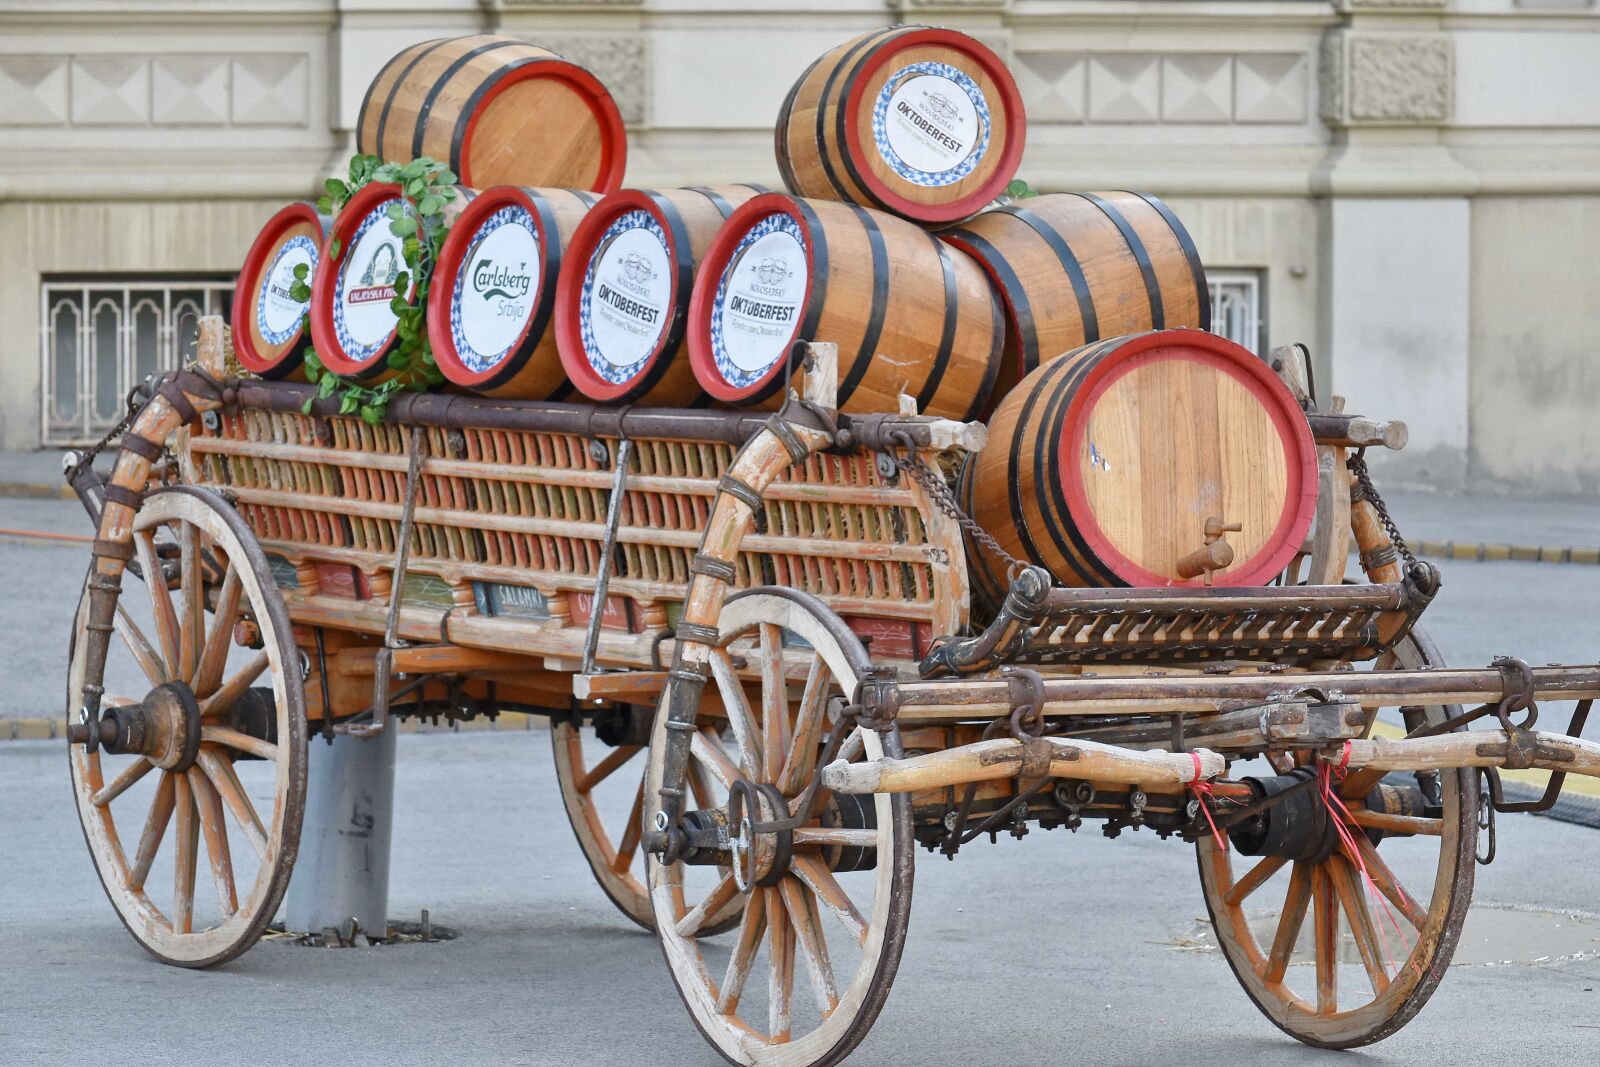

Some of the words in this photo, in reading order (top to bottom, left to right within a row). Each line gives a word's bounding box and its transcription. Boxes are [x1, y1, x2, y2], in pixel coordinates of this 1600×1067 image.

[897, 101, 963, 153] OKTOBERFEST
[271, 284, 293, 300] OKTOBE
[473, 259, 531, 297] Carlsberg
[497, 300, 525, 321] Srbija
[598, 284, 660, 324] OKTOBERFEST
[731, 295, 795, 320] OKTOBERFEST
